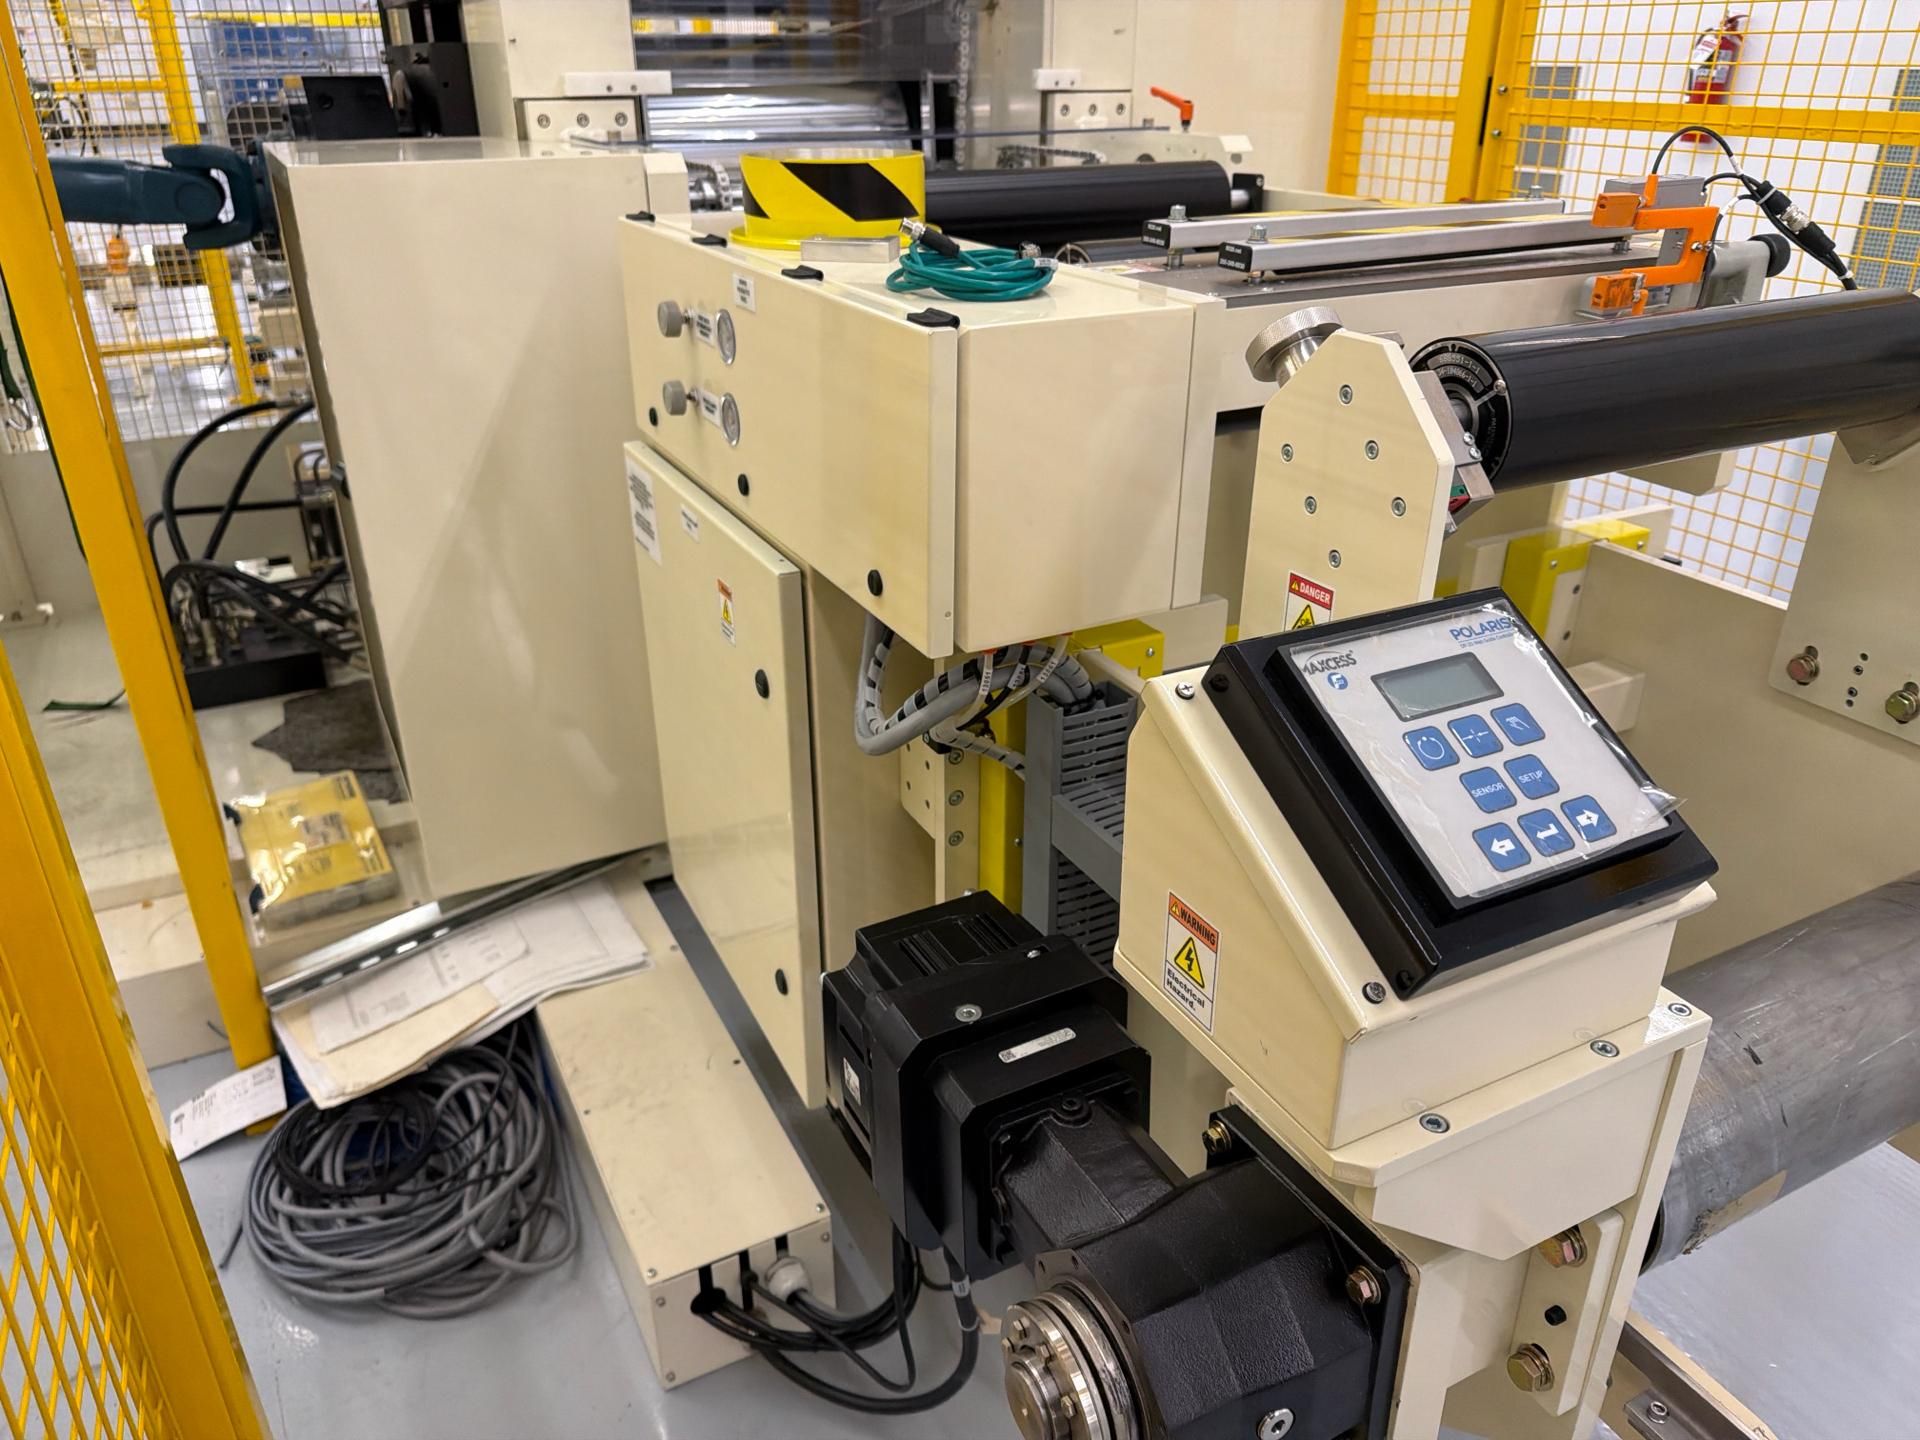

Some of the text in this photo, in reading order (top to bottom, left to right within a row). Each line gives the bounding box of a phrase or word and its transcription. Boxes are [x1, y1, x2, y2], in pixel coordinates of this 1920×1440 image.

[1299, 581, 1331, 604] DANGER
[1449, 617, 1512, 640] POLARIS
[1518, 770, 1544, 785] SETUP
[1471, 782, 1506, 798] SENSOR
[1180, 908, 1216, 946] WARNING
[1165, 978, 1197, 1011] Hazard.
[1167, 968, 1205, 1008] Electrical
